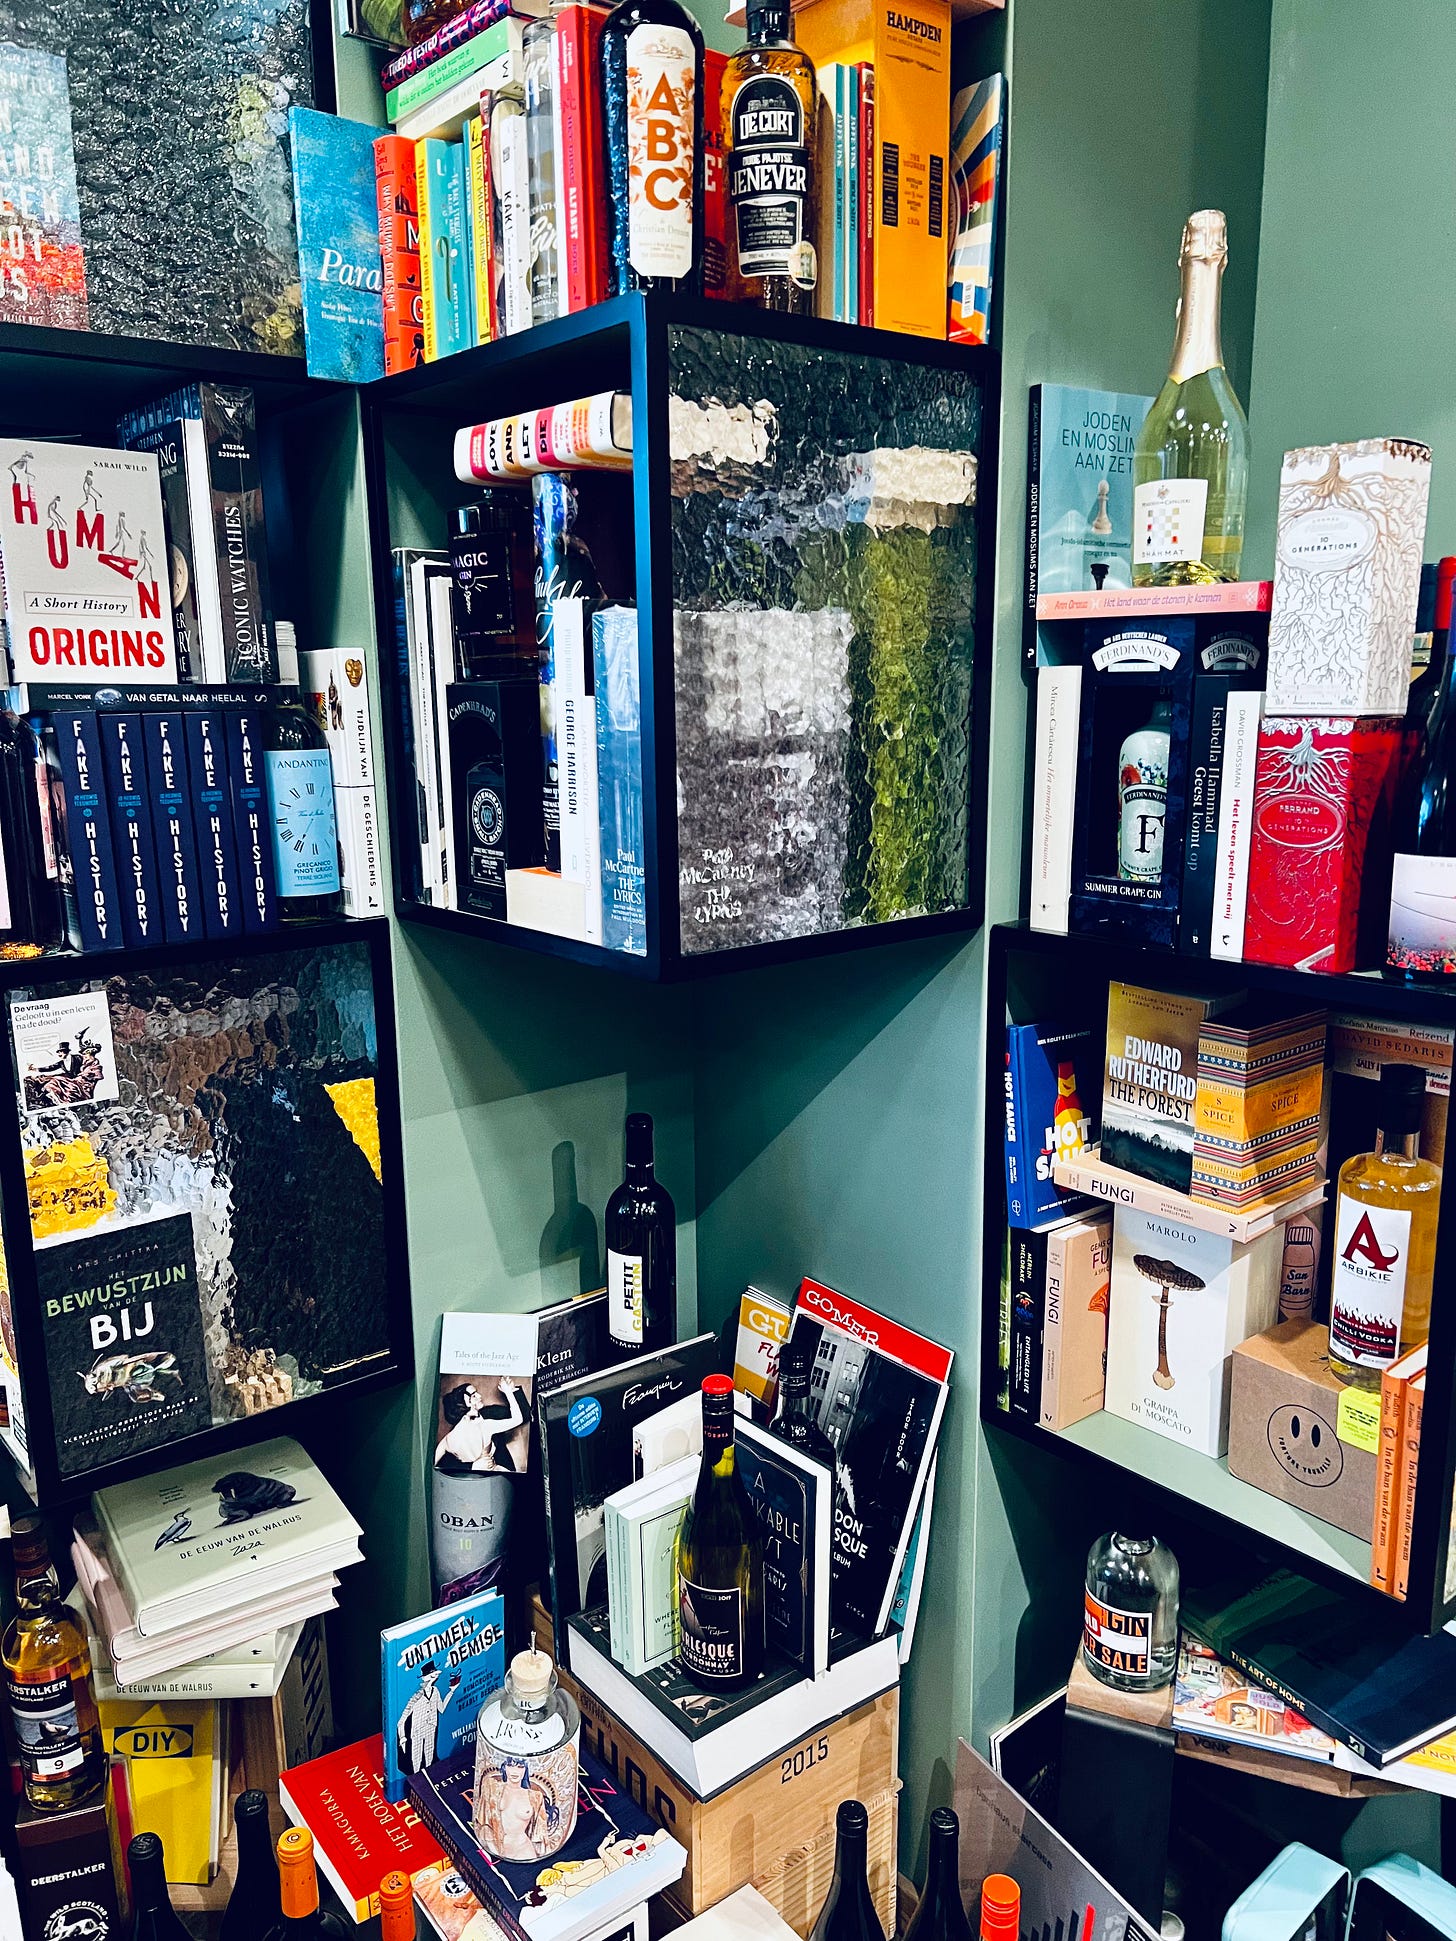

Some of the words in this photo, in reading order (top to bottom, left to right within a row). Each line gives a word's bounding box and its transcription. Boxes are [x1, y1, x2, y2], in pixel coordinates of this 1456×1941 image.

[887, 10, 942, 43] HAMPDEN
[388, 52, 409, 76] TRIED
[412, 35, 438, 62] TESTED
[644, 71, 681, 211] ABC
[475, 154, 483, 185] WHY
[731, 165, 807, 197] JENEVER
[382, 184, 393, 211] WHY
[477, 191, 485, 229] MUMMY
[384, 215, 395, 258] MUMMY
[386, 260, 397, 312] DOESN'T
[1083, 410, 1132, 432] JODEN
[488, 423, 500, 473] LOVE
[505, 423, 515, 465] AND
[522, 422, 531, 459] LET
[539, 419, 548, 454] DIE
[93, 461, 122, 475] SARAH
[124, 464, 148, 473] WILD
[1075, 452, 1105, 472] AAN
[1109, 454, 1133, 473] ZET
[1031, 483, 1039, 507] JODEN
[1031, 508, 1038, 524] EN
[11, 482, 162, 619] HUMAN
[225, 505, 247, 595] WATCHES
[453, 552, 488, 568] MAGIC
[1030, 526, 1038, 569] MOSLIMS
[1029, 571, 1037, 592] AAN
[29, 597, 40, 609] A
[43, 596, 78, 610] Short
[82, 598, 129, 614] History
[394, 598, 406, 621] THE
[1028, 593, 1036, 610] ZET
[236, 599, 254, 665] ICONIC
[28, 626, 166, 668] ORIGINS
[395, 625, 408, 676] BEATLES
[1100, 644, 1169, 663] FERDINAND'S
[47, 693, 71, 702] MARCEL
[72, 693, 92, 702] VONK
[126, 693, 148, 703] VAN
[149, 694, 181, 703] GETAL
[182, 693, 208, 703] NAAR
[210, 694, 248, 704] HEELAL
[449, 699, 496, 724] CADENHEAD'S
[356, 709, 368, 754] TIJDLIJN
[565, 699, 577, 748] GEORGE
[1209, 706, 1225, 763] Isabella
[1238, 709, 1246, 738] DAVID
[360, 756, 368, 778] VAN
[1234, 739, 1245, 790] GROSSMAN
[567, 751, 578, 817] HARRISON
[1192, 766, 1207, 813] Geest
[362, 795, 371, 808] DE
[1205, 767, 1220, 834] Hammad
[1233, 798, 1242, 819] Het
[1279, 804, 1320, 815] FERRAND
[72, 720, 91, 791] FAKE
[84, 822, 108, 940] HISTORY
[159, 721, 176, 790] FAKE
[169, 819, 189, 933] HISTORY
[240, 718, 254, 785] FAKE
[249, 813, 267, 923] HISTORY
[1190, 813, 1204, 852] komt
[1230, 820, 1241, 848] leven
[364, 811, 377, 887] GESCHIEDENIS
[617, 848, 635, 865] Paul
[1186, 853, 1199, 872] op
[1227, 849, 1238, 881] speelt
[613, 888, 642, 905] LYRICS
[619, 877, 636, 892] THE
[1084, 882, 1118, 895] SUMMER
[1119, 885, 1146, 897] GRAPE
[1146, 888, 1162, 899] GIN
[1226, 881, 1235, 899] met
[1223, 899, 1233, 921] mij
[14, 1005, 26, 1014] De
[26, 1003, 50, 1013] vraag
[15, 1010, 45, 1022] Gelooft
[45, 1010, 51, 1018] u
[51, 1009, 60, 1017] in
[60, 1008, 75, 1016] een
[75, 1004, 96, 1014] leven
[16, 1023, 27, 1031] na
[26, 1019, 38, 1029] de
[37, 1016, 62, 1028] dood?
[1124, 1035, 1183, 1072] EDWARD
[1004, 1072, 1014, 1100] HOT
[1108, 1054, 1198, 1102] RUTHERFURD
[1109, 1078, 1137, 1105] THE
[1138, 1089, 1194, 1123] FOREST
[1271, 1094, 1299, 1113] SPICE
[1005, 1102, 1016, 1143] SAUCE
[1202, 1109, 1236, 1125] SPICE
[1044, 1117, 1092, 1151] HOT
[1091, 1179, 1136, 1205] FUNGI
[1146, 1221, 1197, 1245] MAROLO
[69, 1258, 99, 1273] LARS
[108, 1270, 126, 1280] HET
[1019, 1243, 1027, 1283] SHELDRAKE
[1341, 1261, 1392, 1281] ARBIKIE
[46, 1263, 187, 1317] BEWUSTZIJN
[623, 1262, 635, 1311] PETIT
[632, 1262, 643, 1333] GASTON
[1047, 1276, 1060, 1325] FUNGI
[103, 1301, 122, 1311] VAN
[125, 1296, 138, 1304] DE
[89, 1301, 155, 1350] BIJ
[806, 1289, 881, 1350] GOMER
[1333, 1318, 1358, 1336] CHILLI
[1359, 1332, 1394, 1344] VODKA
[537, 1348, 573, 1370] Klem
[1130, 1402, 1142, 1414] DI
[1144, 1406, 1192, 1436] MOSCATO
[1143, 1396, 1179, 1419] GRAPPA
[440, 1513, 494, 1528] OBAN
[179, 1551, 194, 1560] DE
[196, 1541, 224, 1555] EEUW
[226, 1532, 246, 1545] VAN
[248, 1528, 263, 1538] DE
[263, 1514, 303, 1533] WALRUS
[404, 1615, 475, 1670] UNTIMELY
[449, 1625, 504, 1669] DEMISE
[1101, 1646, 1148, 1673] SALE
[116, 1684, 127, 1694] DE
[129, 1684, 151, 1694] EEUW
[152, 1684, 168, 1694] VAN
[169, 1683, 179, 1693] DE
[181, 1682, 214, 1692] WALRUS
[1230, 1650, 1247, 1669] THE
[1247, 1664, 1265, 1682] ART
[1265, 1678, 1279, 1692] OF
[1278, 1686, 1306, 1713] HOME
[132, 1730, 176, 1753] DIY
[1191, 1736, 1232, 1755] VONK
[780, 1735, 831, 1786] 2015
[346, 1765, 372, 1793] VAN
[434, 1769, 470, 1791] PETER
[363, 1790, 395, 1826] BOEK
[319, 1788, 371, 1861] KAMAGURKA
[385, 1826, 415, 1853] HET
[31, 1862, 106, 1887] DEERSTALKER
[49, 1904, 70, 1919] WILD
[70, 1901, 108, 1916] SCOTLAND
